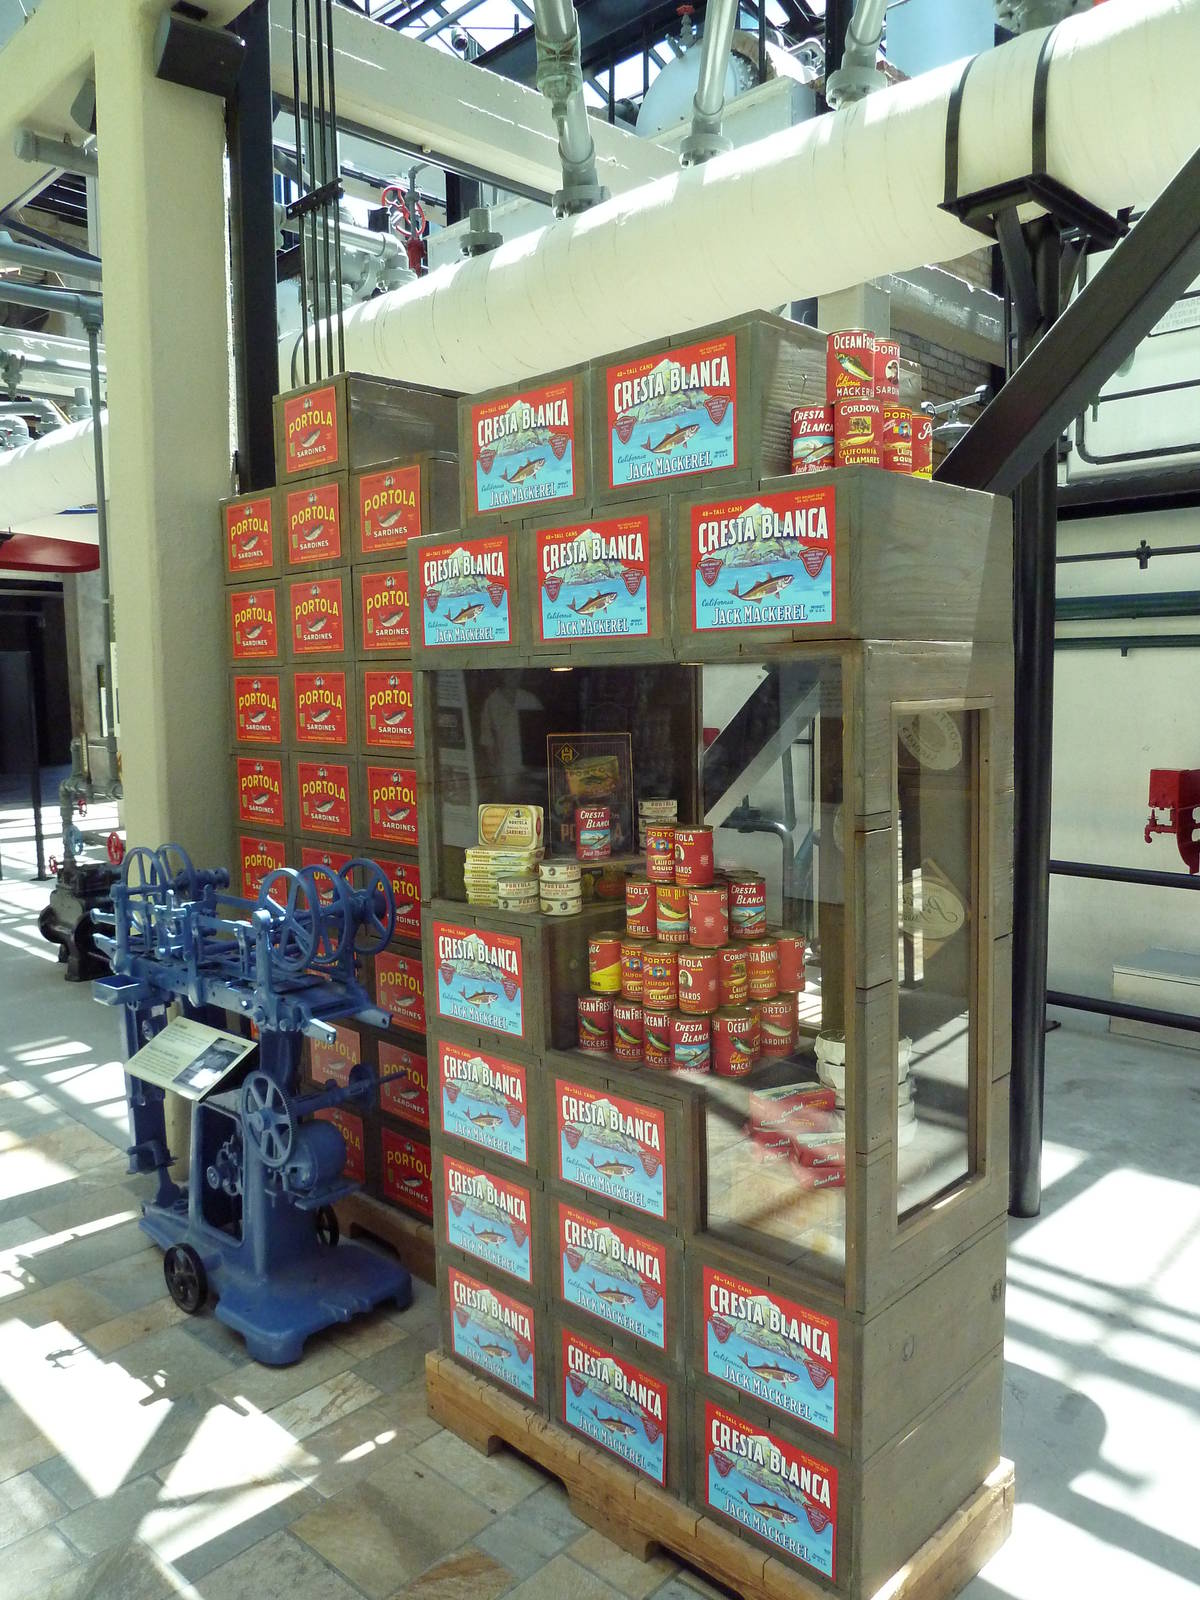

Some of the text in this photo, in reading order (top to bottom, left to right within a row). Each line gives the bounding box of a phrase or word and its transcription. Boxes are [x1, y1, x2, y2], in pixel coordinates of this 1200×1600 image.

[874, 345, 900, 356] PORT
[613, 357, 730, 413] CRESTA BLANCA
[794, 410, 824, 423] CRESTA
[840, 405, 880, 416] CORDOVA
[289, 410, 332, 438] PORTOLA
[477, 399, 570, 446] CRESTA BLANCA
[800, 421, 834, 434] BLANCA
[297, 445, 326, 458] SARDINES
[839, 448, 877, 459] CALIFORNIA
[627, 450, 712, 481] JACK MACKEREL
[364, 489, 415, 515] PORTOLA
[490, 480, 557, 505] JACK MACKEREL
[291, 506, 335, 530] PORTOLA
[702, 505, 743, 517] 48-TALL CANS
[230, 522, 268, 540] PORTOLA
[374, 526, 407, 538] SARDINES
[698, 506, 829, 554] CRESTA BLANCA
[300, 540, 328, 550] SARDINES
[542, 534, 645, 574] CRESTA BLANCA
[423, 553, 506, 588] CRESTA BLANCA
[295, 598, 338, 620] PORTOLA
[366, 589, 409, 614] PORTOL
[701, 598, 734, 608] California
[235, 610, 273, 627] PORTOLA
[712, 603, 808, 626] JACK MACKEREL
[304, 632, 332, 641] SARDINES
[376, 628, 409, 636] SARDINES
[435, 627, 495, 644] JACK MACKEREL
[555, 618, 630, 638] JACK MACKEREL
[239, 693, 277, 711] PORTOLA
[299, 690, 342, 710] PORTOLA
[370, 690, 412, 709] PORTOL
[378, 727, 412, 735] SARDINES
[241, 776, 279, 794] PORTOLA
[302, 781, 346, 802] PORTOLA
[373, 787, 416, 805] PORTOL
[310, 813, 340, 823] SARDINES
[580, 811, 605, 819] CRESTA
[382, 821, 416, 832] SARDINES
[731, 885, 756, 893] CRESTA
[437, 935, 518, 976] CRESTA BLANCA
[380, 972, 424, 996] PORTOL
[389, 1004, 422, 1019] SARDINES
[675, 1022, 702, 1032] CRESTA
[383, 1064, 429, 1091] PORTOL
[443, 1054, 523, 1104] CRESTA BLANCA
[392, 1096, 425, 1114] SARDINES
[561, 1095, 660, 1153] CRESTA BLANCA
[396, 1184, 428, 1202] SARDINES
[448, 1169, 527, 1226] CRESTA BLANCA
[574, 1168, 645, 1207] JACK MACKEREL
[564, 1218, 661, 1286] CRESTA BLANCA
[737, 1284, 752, 1296] CANS
[453, 1280, 531, 1343] CRESTA BLANCA
[576, 1290, 646, 1334] JACK MACKEREL
[710, 1283, 832, 1363] CRESTA BLANCA
[567, 1345, 661, 1422] CRESTA BLANCA
[722, 1364, 811, 1419] JACK MACKEREL
[711, 1419, 831, 1509] CRESTA BLANCA
[722, 1497, 810, 1560] JACK MACKEREL
